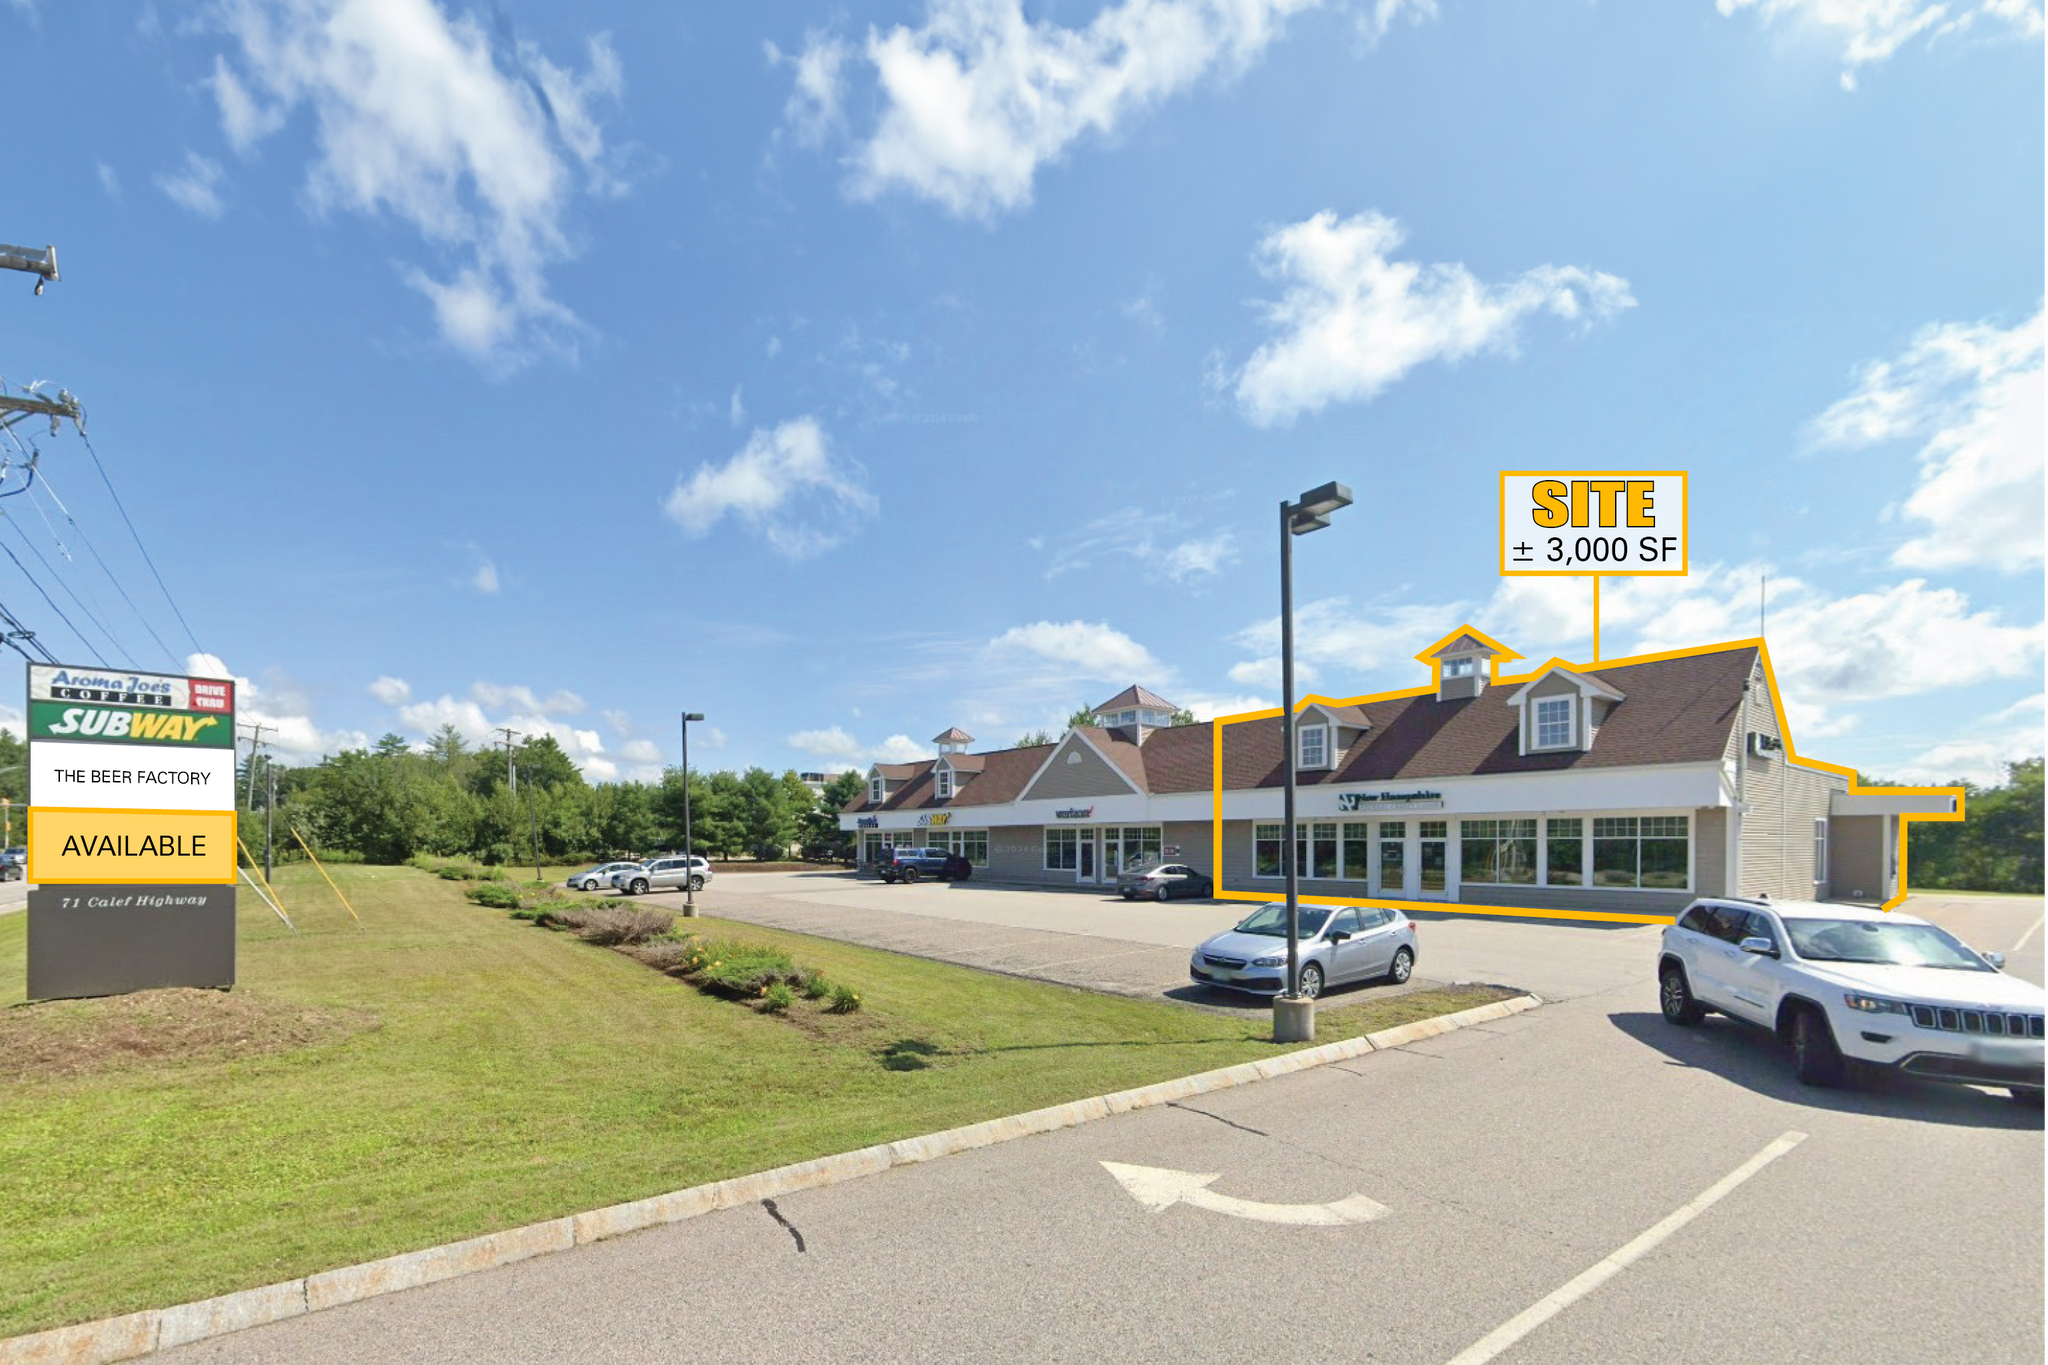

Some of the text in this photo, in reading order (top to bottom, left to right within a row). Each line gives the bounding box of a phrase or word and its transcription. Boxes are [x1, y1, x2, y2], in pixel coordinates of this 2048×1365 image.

[52, 670, 123, 690] Aroma
[60, 688, 163, 705] COFFEE
[194, 684, 226, 697] DRIVE
[48, 708, 218, 741] SUBWAY
[62, 895, 208, 909] 71 Calef Highway
